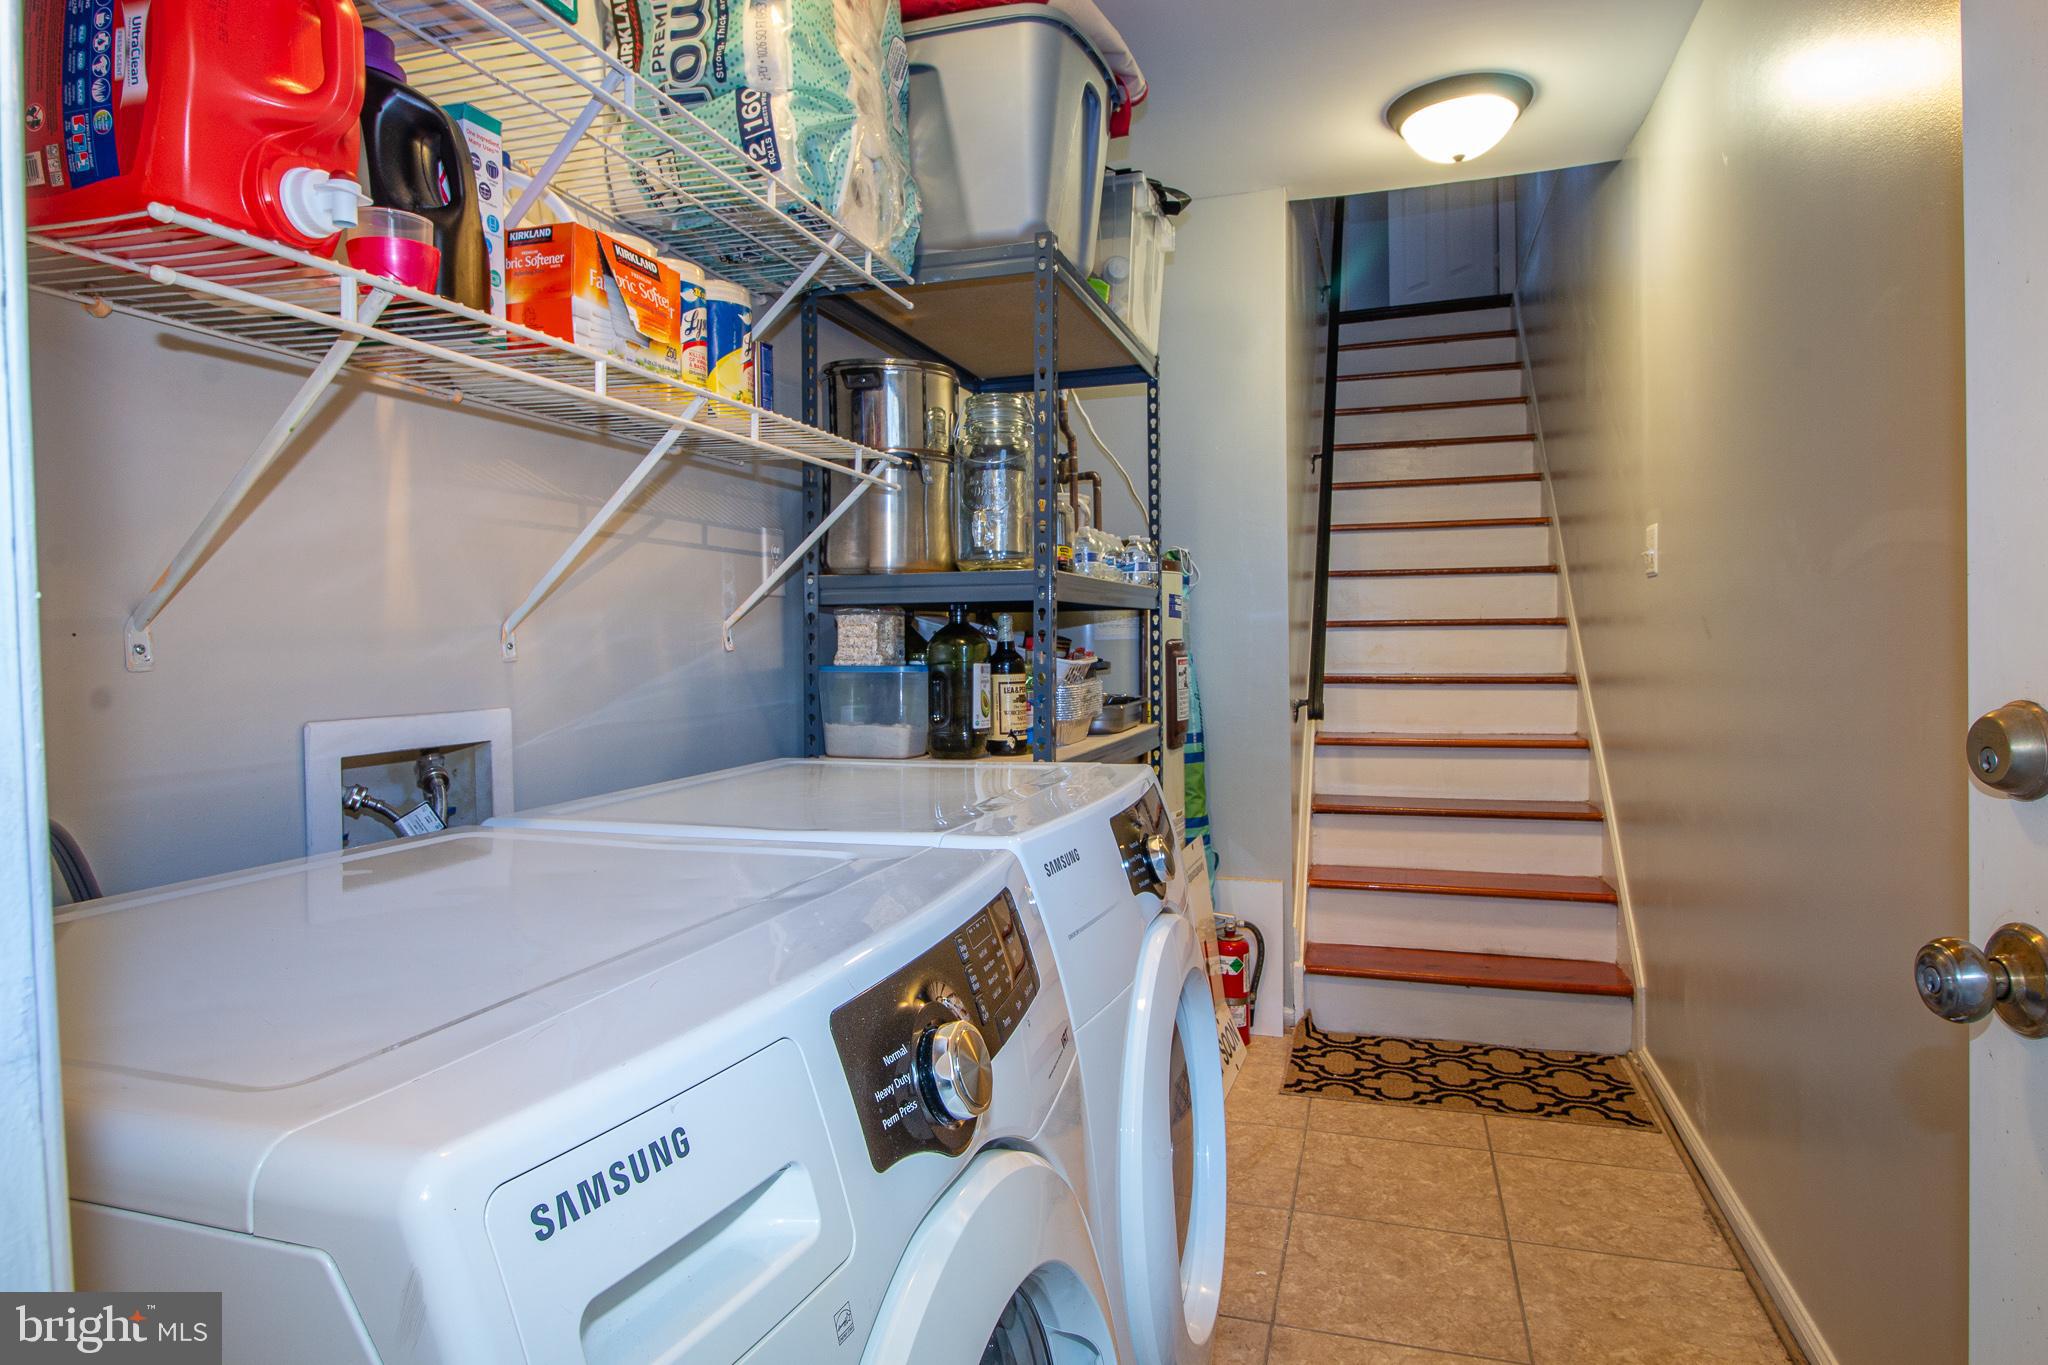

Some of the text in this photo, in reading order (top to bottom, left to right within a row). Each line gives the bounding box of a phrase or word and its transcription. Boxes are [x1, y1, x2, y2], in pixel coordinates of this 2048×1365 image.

[717, 15, 727, 39] Thick
[131, 16, 141, 85] UltraClean
[741, 89, 764, 127] 160
[765, 137, 777, 165] ROLLS
[510, 228, 552, 241] KIRKLAND
[525, 252, 565, 268] Softener
[614, 244, 658, 274] KIRKLAND
[1004, 686, 1014, 694] LEA
[1044, 848, 1080, 877] SAMSUNG
[883, 1044, 908, 1066] Normal
[875, 1072, 911, 1103] Heavy Duty
[882, 1099, 918, 1130] Perm Press
[530, 1126, 691, 1242] SAMSUNG
